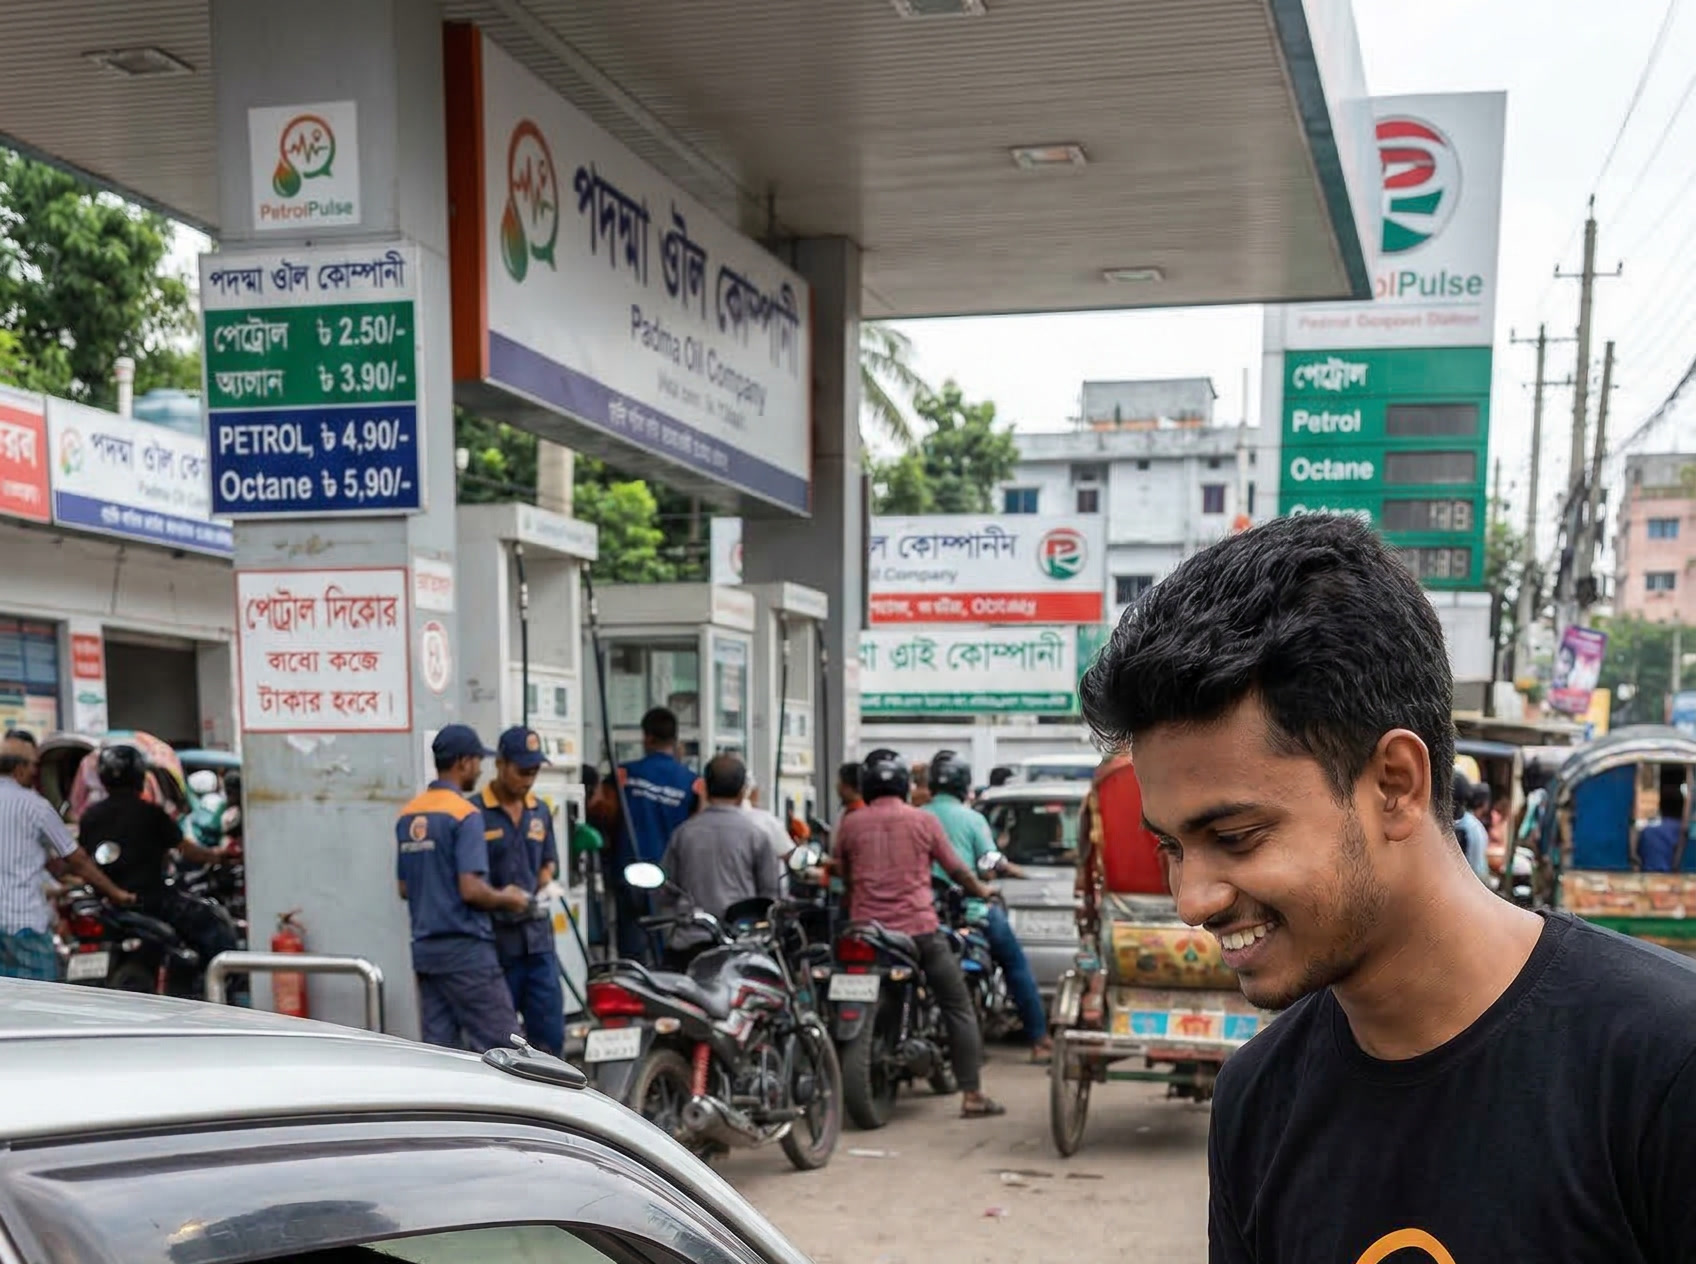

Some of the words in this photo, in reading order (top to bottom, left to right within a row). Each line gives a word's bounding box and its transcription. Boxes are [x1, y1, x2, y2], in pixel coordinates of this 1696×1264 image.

[259, 200, 354, 221] PetrolPulse
[339, 314, 406, 346] 2.50/-
[340, 360, 407, 392] 3.90/-
[631, 304, 680, 365] Padma
[684, 336, 704, 374] Oil
[707, 349, 767, 416] Company
[1292, 408, 1361, 433] Petrol
[219, 423, 314, 459] PETROL,
[1290, 456, 1374, 481] Octane
[219, 469, 313, 501] Octane
